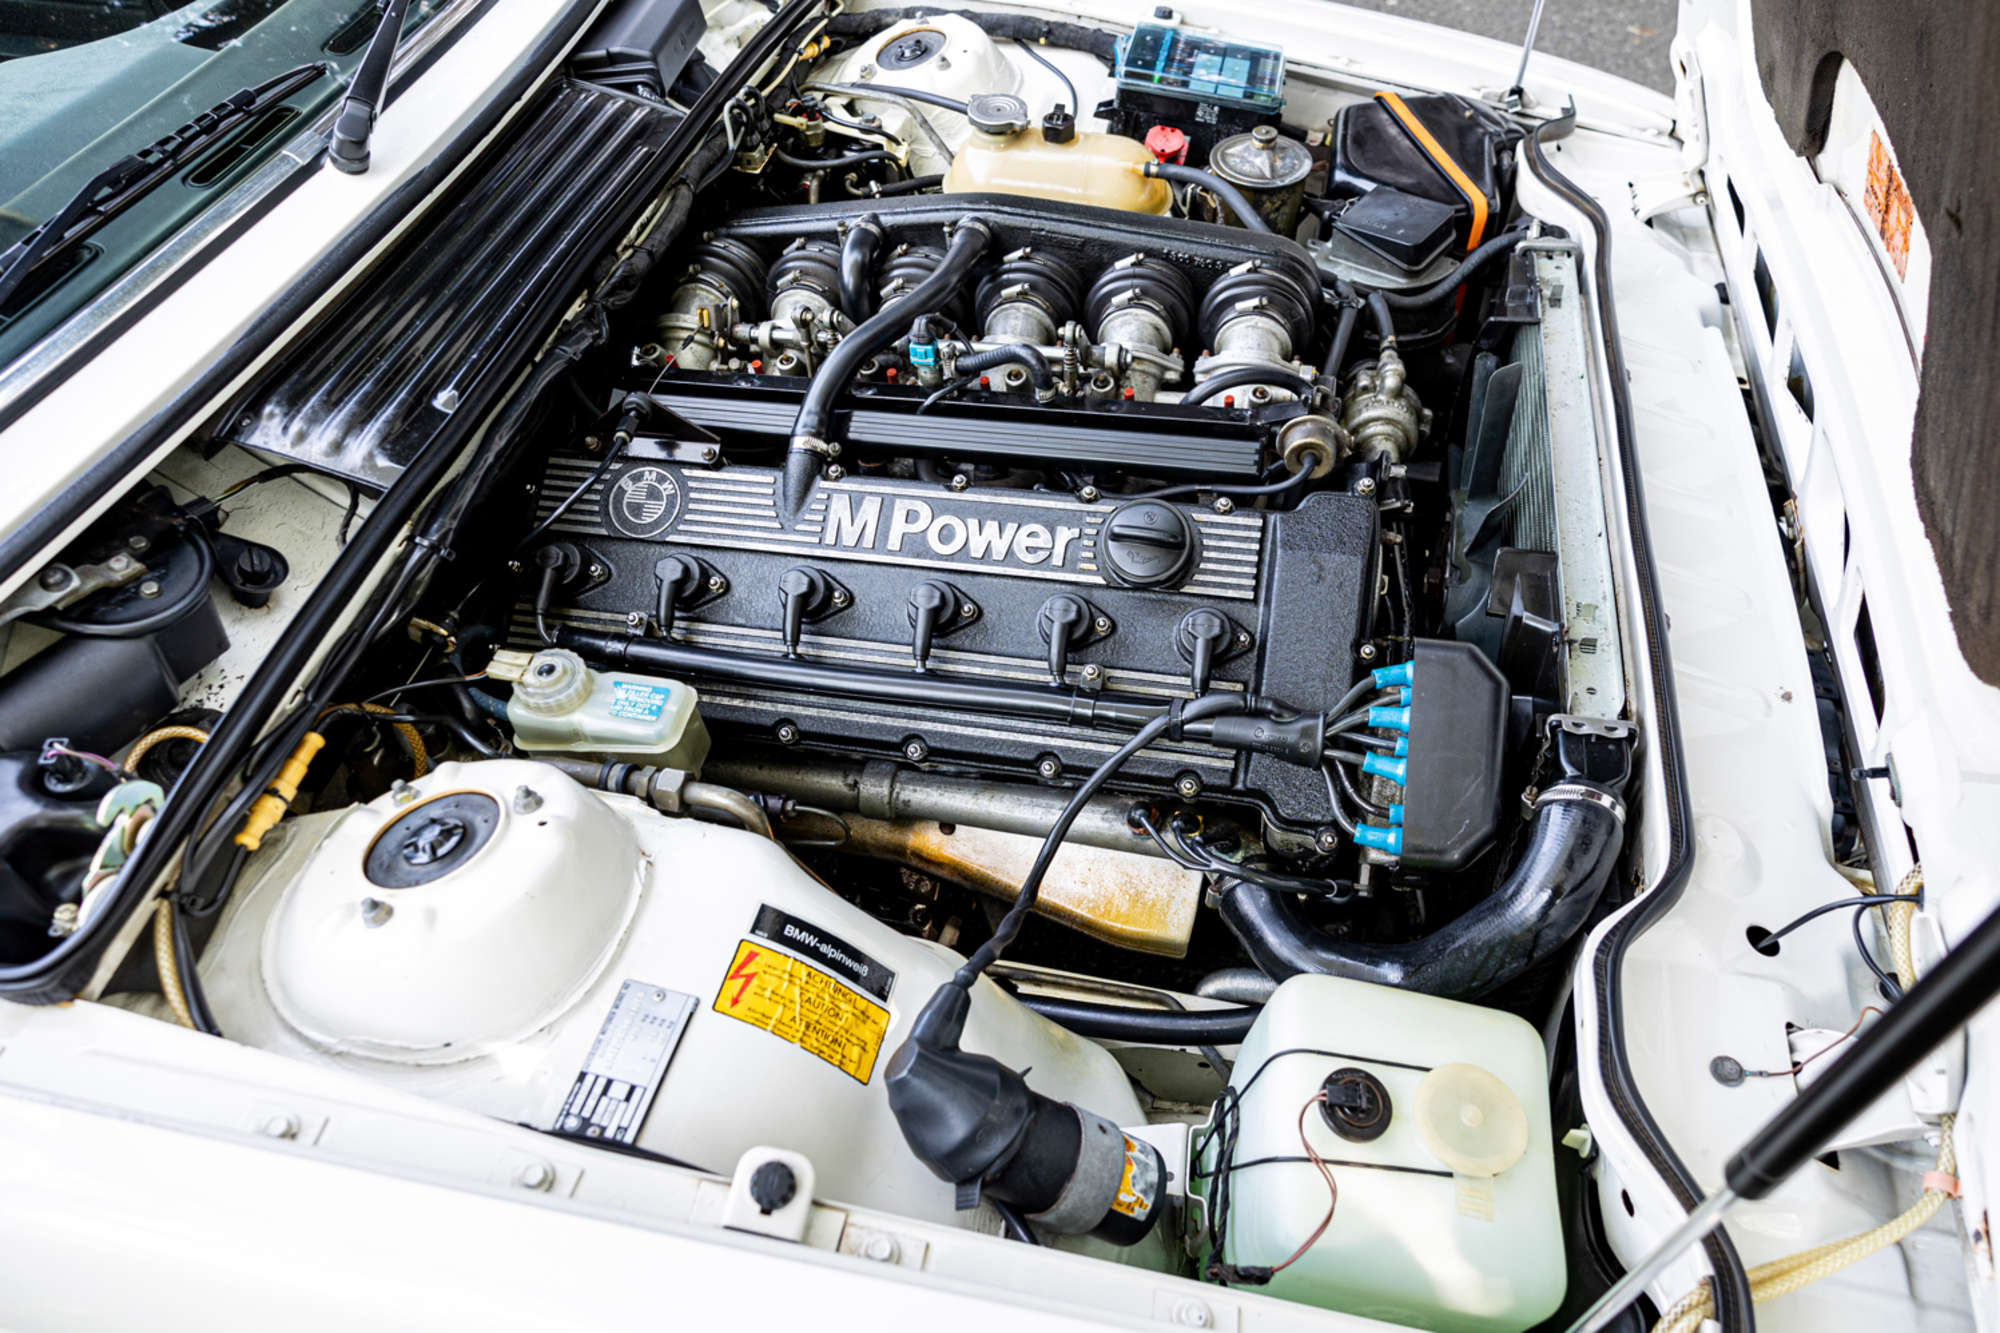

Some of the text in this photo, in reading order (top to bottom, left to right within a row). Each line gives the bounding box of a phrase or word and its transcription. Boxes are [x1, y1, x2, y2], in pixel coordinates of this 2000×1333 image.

[620, 470, 676, 495] BMW
[824, 493, 1081, 568] M Power
